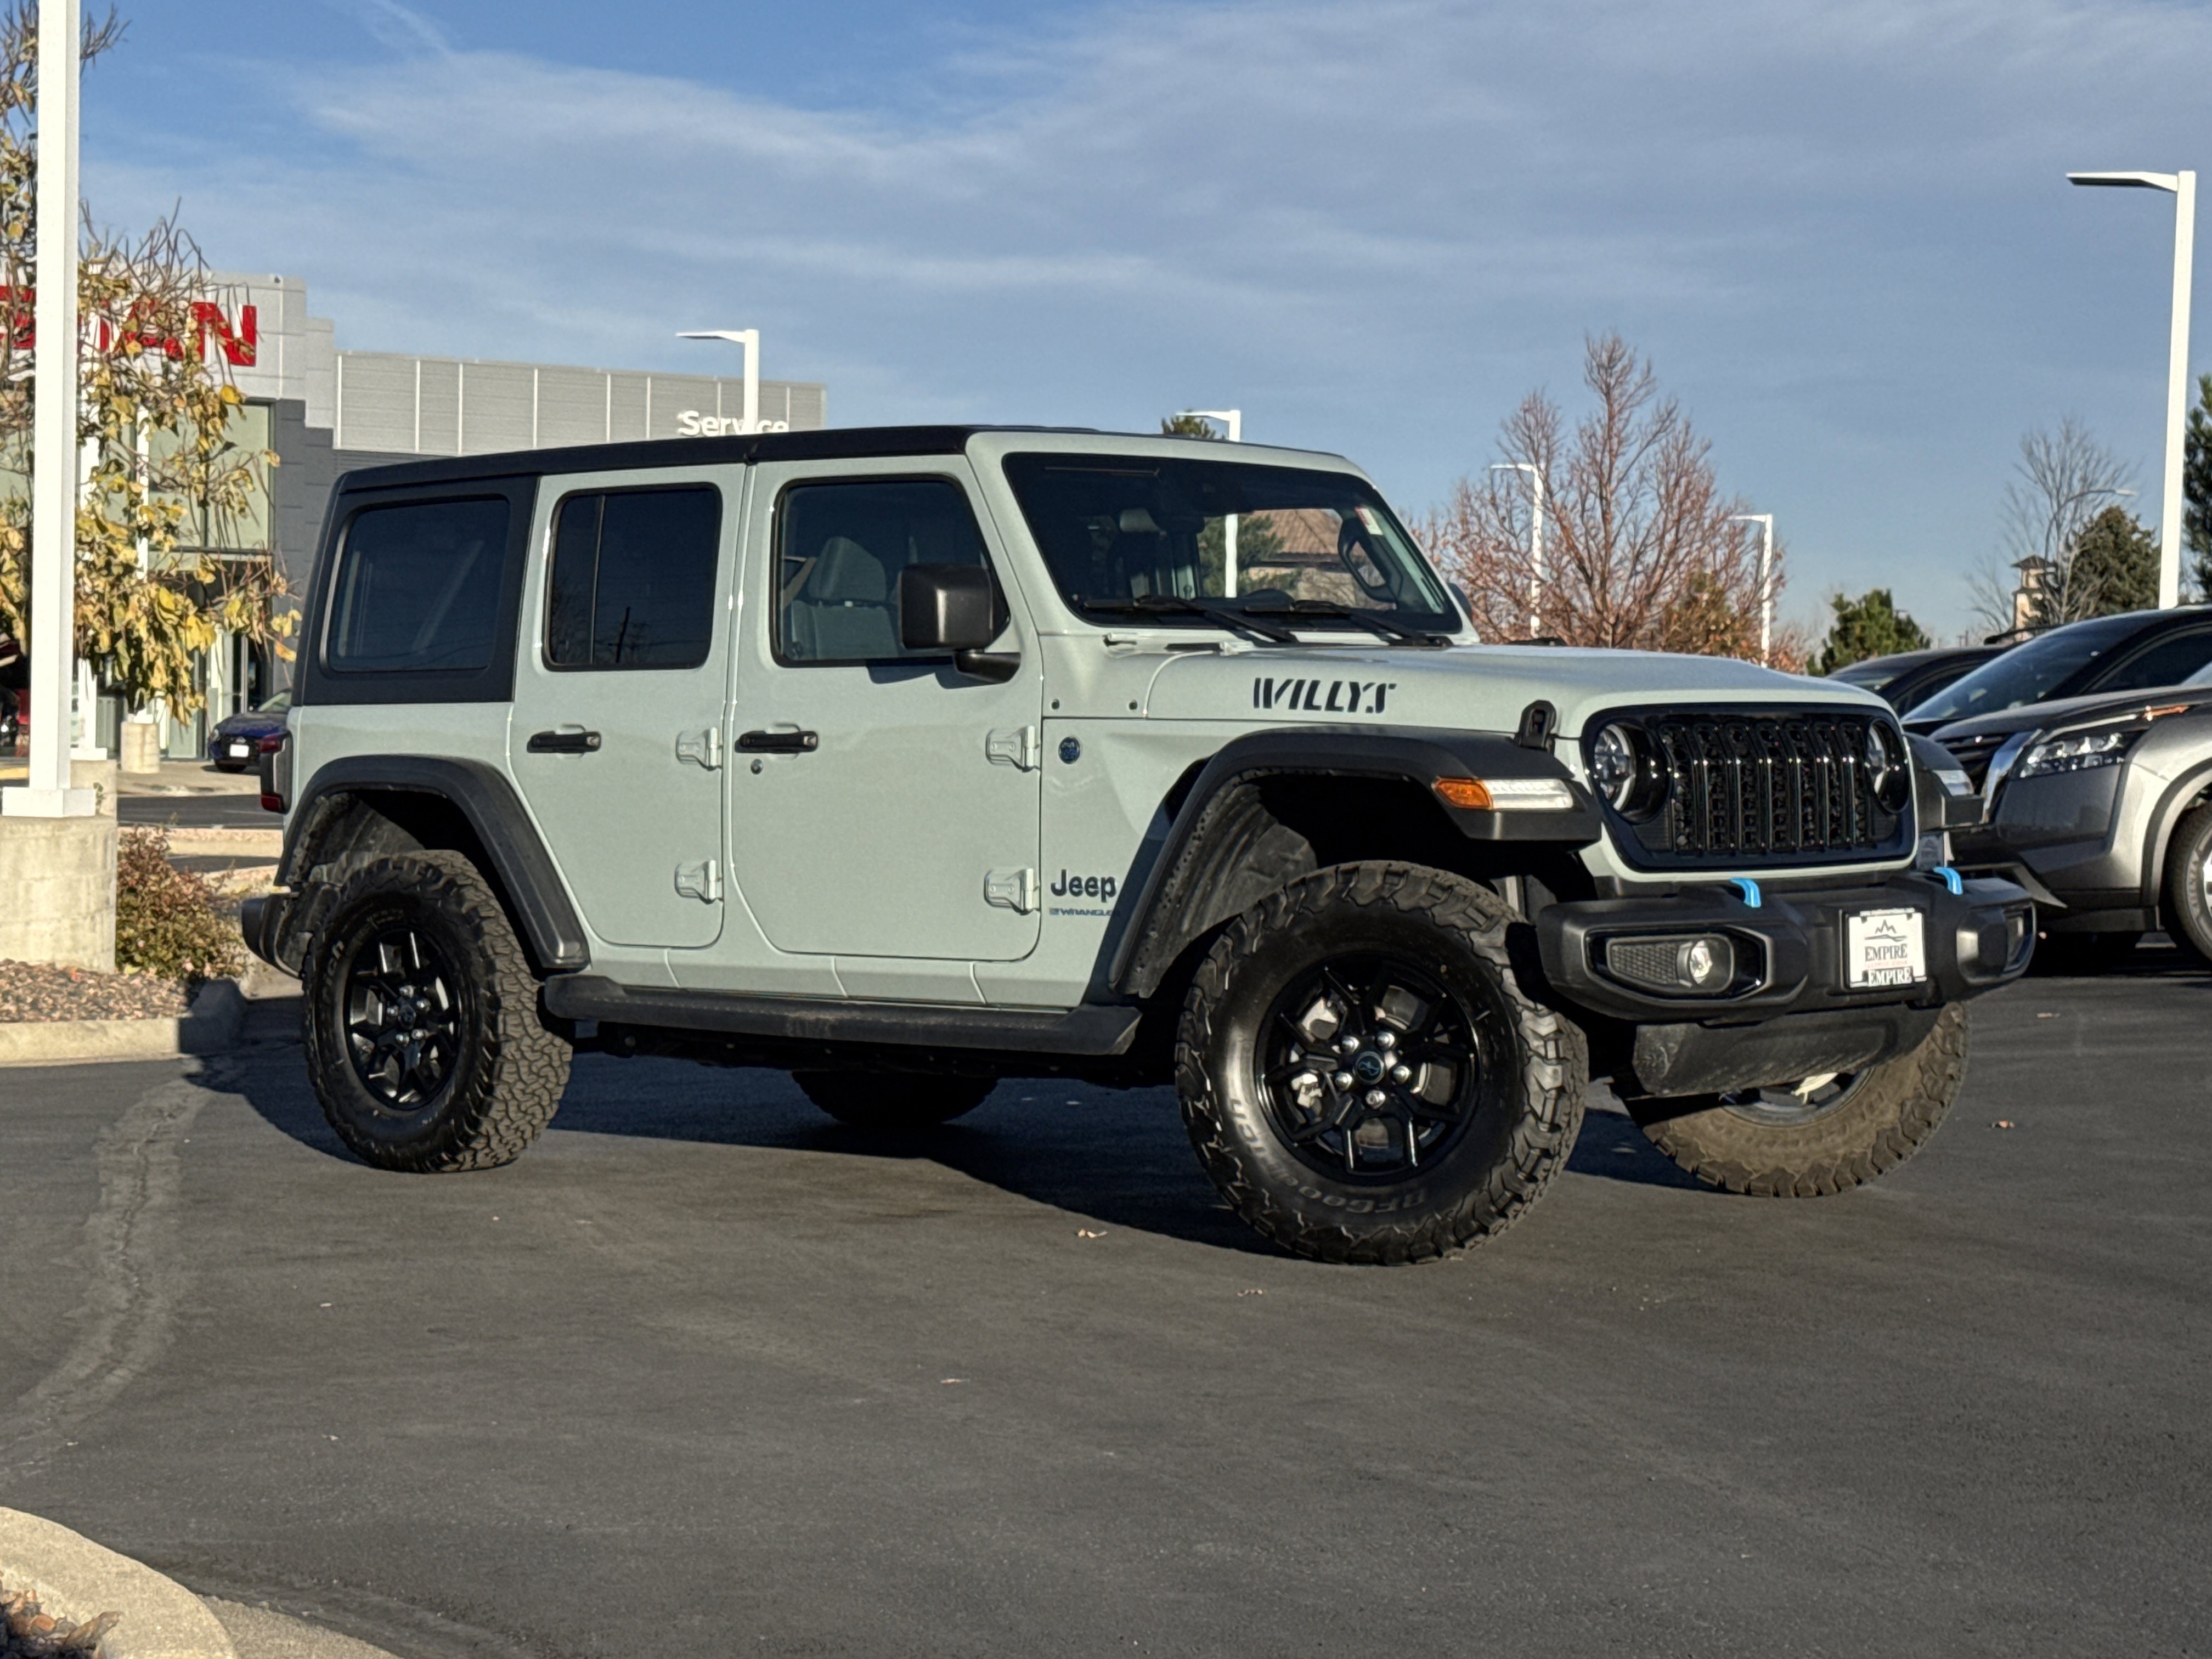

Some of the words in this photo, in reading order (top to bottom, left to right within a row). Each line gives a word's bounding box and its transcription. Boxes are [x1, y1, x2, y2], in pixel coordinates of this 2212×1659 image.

[677, 410, 789, 437] Servce
[1253, 678, 1397, 714] WILLYS
[1051, 868, 1117, 903] Jeep
[1060, 908, 1115, 917] WRANGLE
[1865, 943, 1908, 962] EMPIRE
[1867, 967, 1912, 987] EMPIRE
